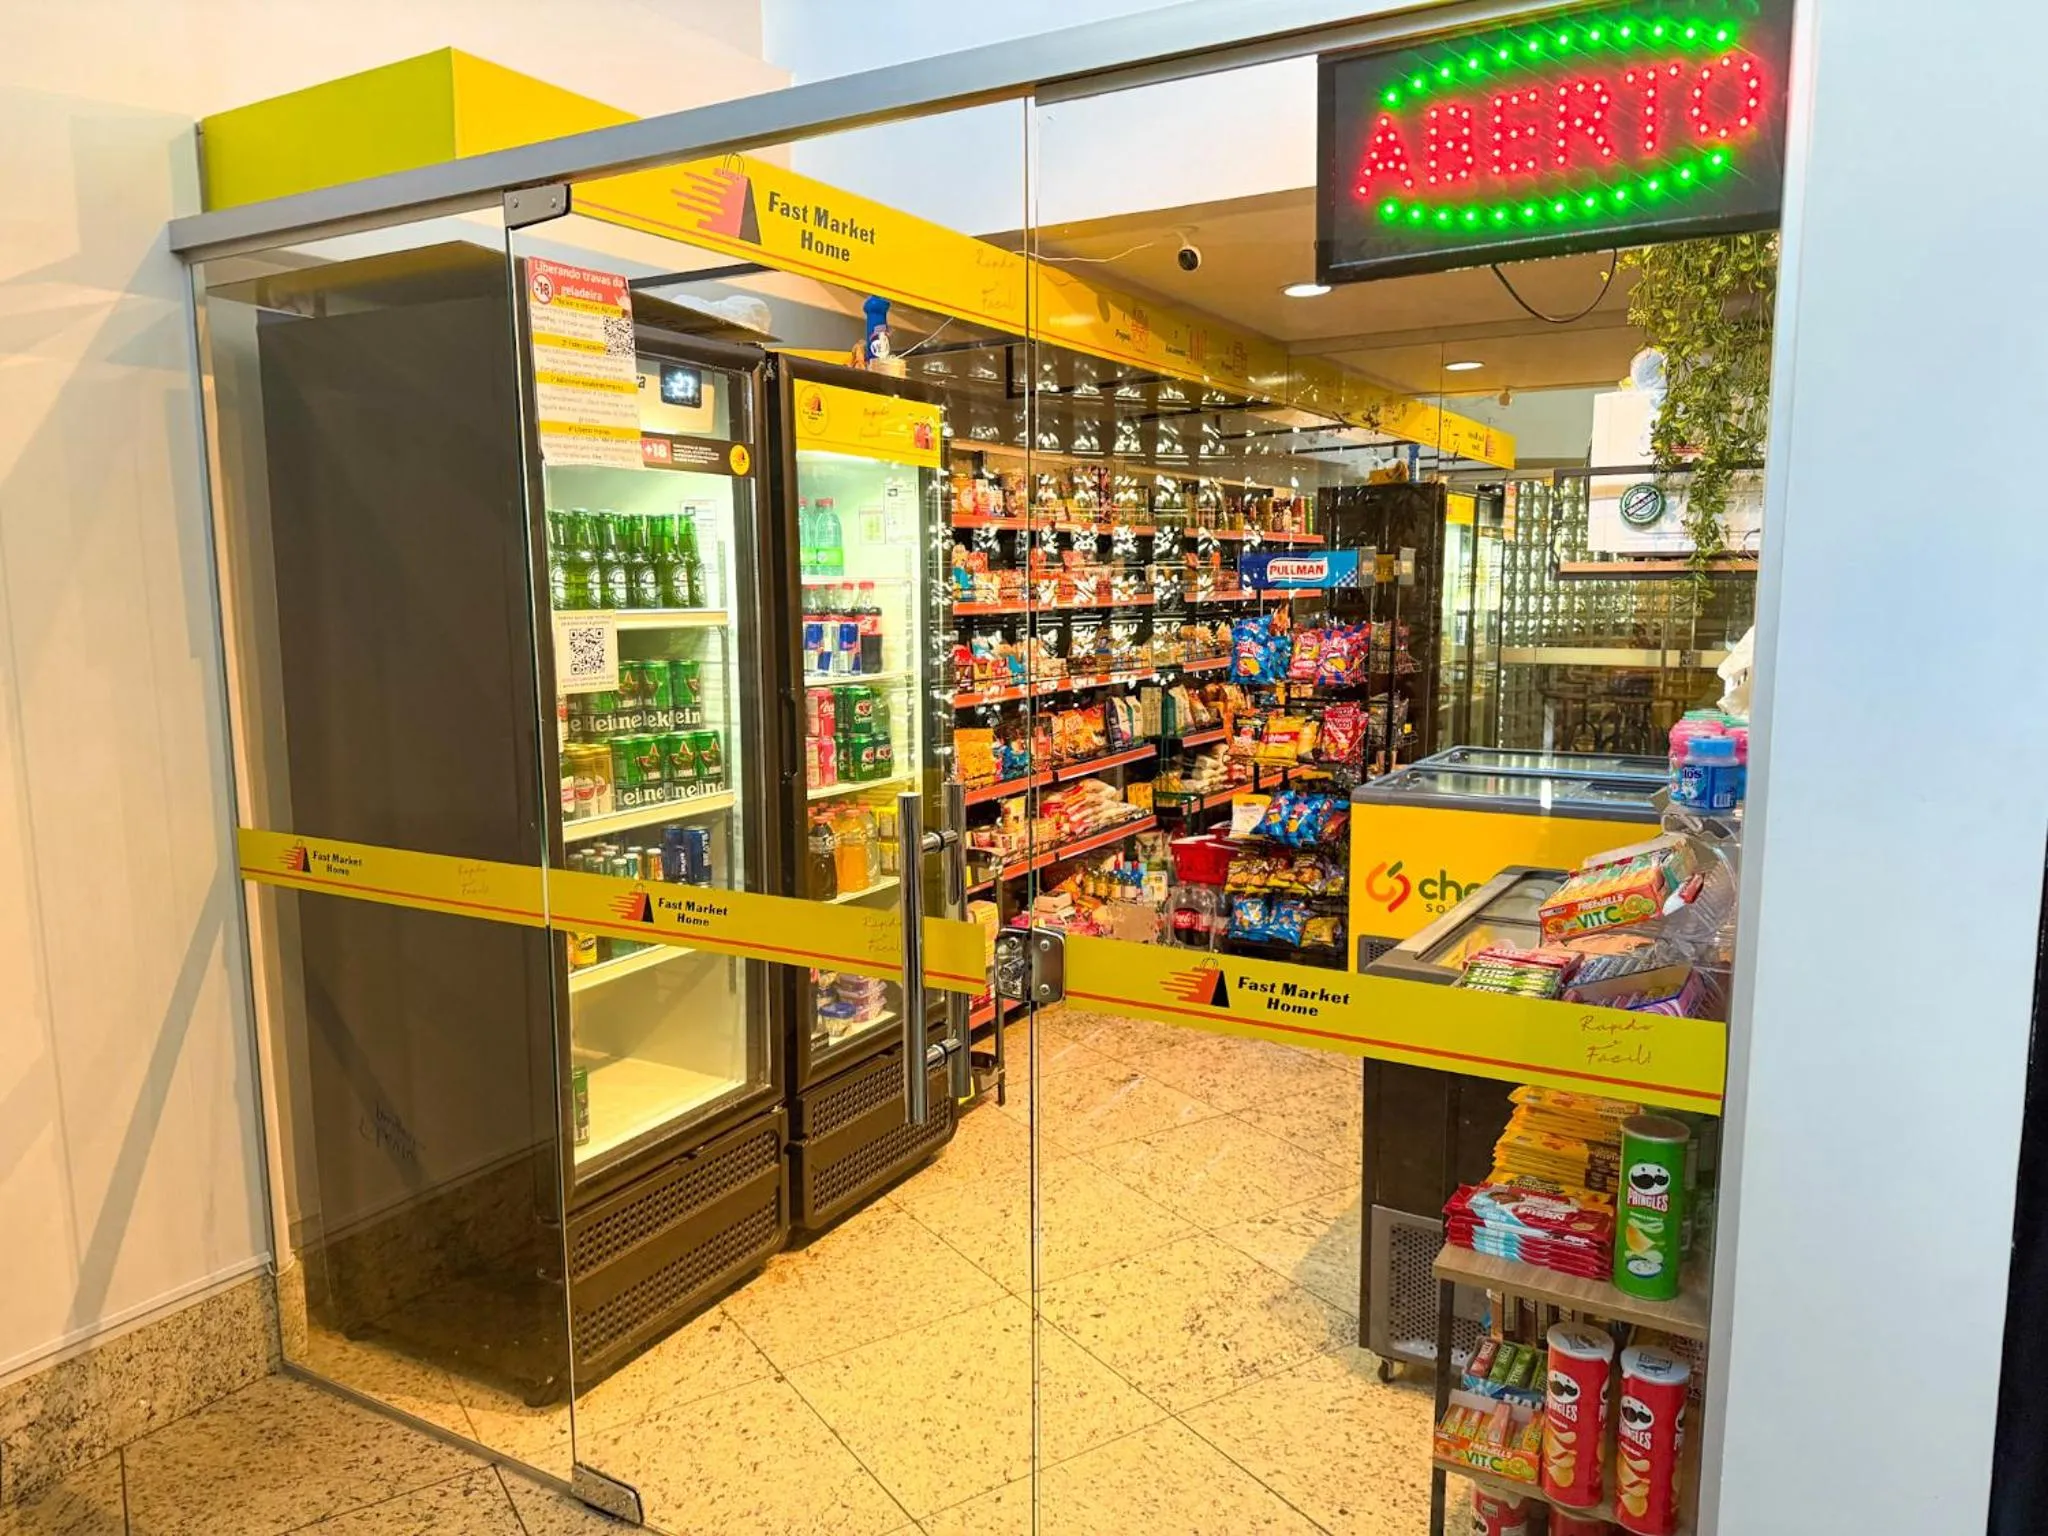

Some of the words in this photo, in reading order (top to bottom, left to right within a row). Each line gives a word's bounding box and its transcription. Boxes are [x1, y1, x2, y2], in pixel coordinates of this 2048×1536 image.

[1356, 53, 1761, 196] ABERTO
[768, 191, 808, 223] Fast
[813, 205, 875, 245] Market
[801, 229, 850, 262] Home
[1269, 564, 1324, 577] PULLMAN
[313, 850, 330, 862] Fast
[332, 853, 362, 867] Market
[326, 864, 350, 876] Home
[658, 897, 682, 911] Fast
[685, 901, 728, 916] Market
[677, 913, 709, 927] Home
[1238, 976, 1277, 994] Fast
[1281, 983, 1351, 1005] Market
[1267, 997, 1319, 1017] Home
[1627, 1187, 1668, 1212] PRINGLES
